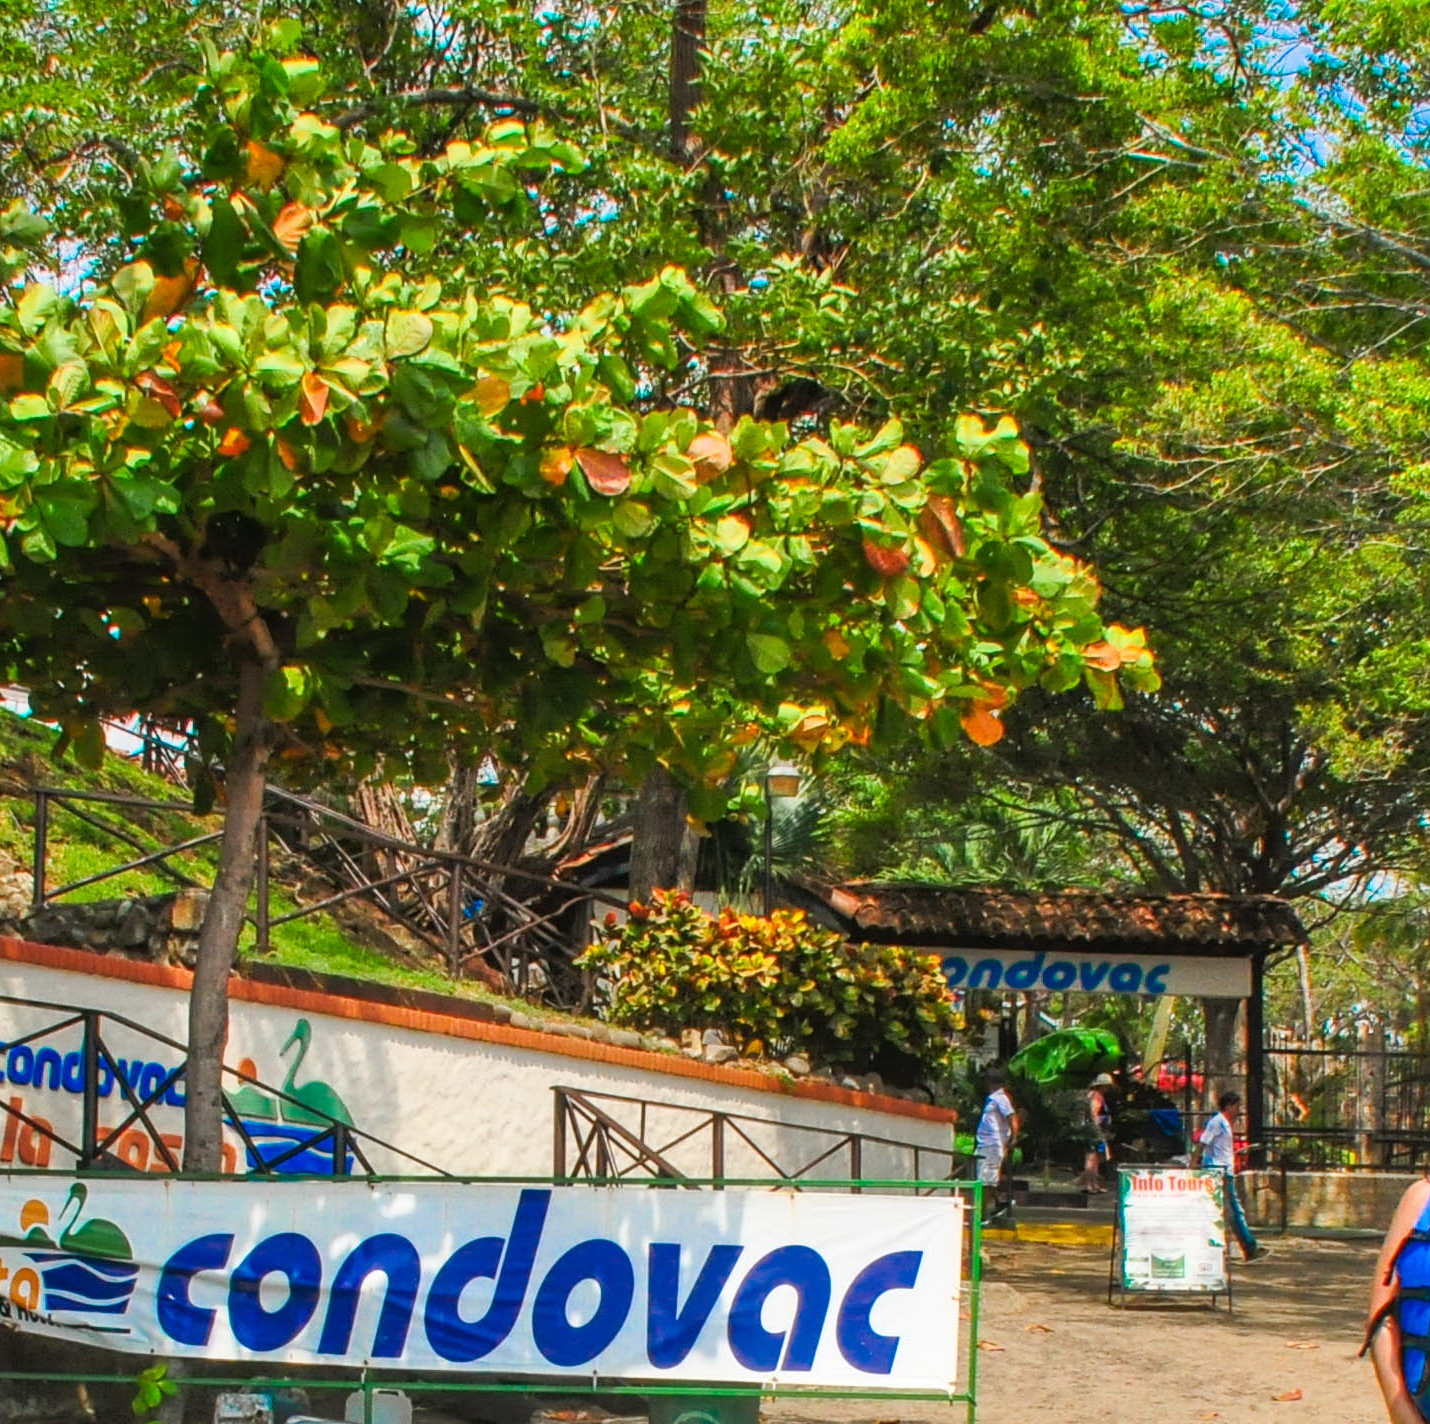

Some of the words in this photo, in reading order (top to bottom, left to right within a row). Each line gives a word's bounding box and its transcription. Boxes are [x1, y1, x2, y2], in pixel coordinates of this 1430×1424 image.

[941, 951, 1170, 994] ondovac
[1131, 1175, 1164, 1192] Info
[1168, 1175, 1216, 1195] Tours
[157, 1189, 921, 1374] condovac
